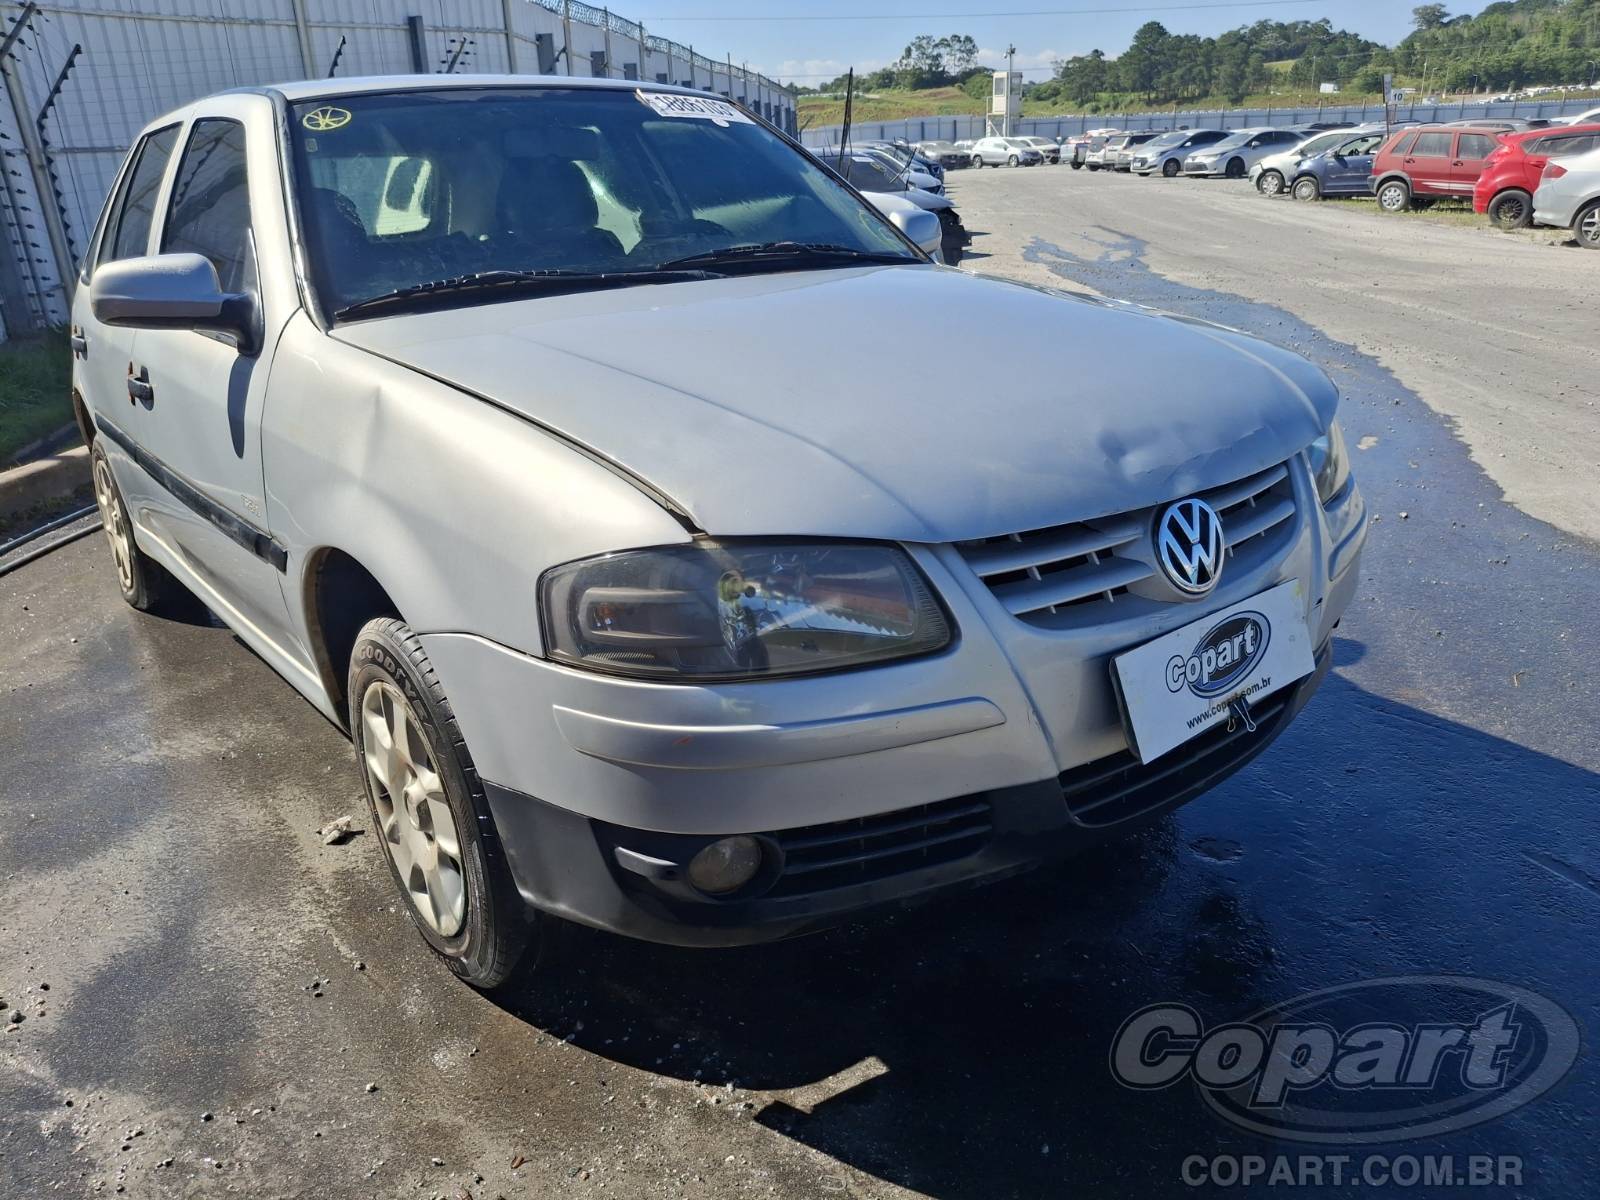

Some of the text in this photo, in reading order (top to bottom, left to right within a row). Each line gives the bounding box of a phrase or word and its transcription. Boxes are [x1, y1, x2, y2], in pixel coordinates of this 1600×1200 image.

[1393, 93, 1403, 101] 10
[1165, 618, 1258, 693] Copart
[1186, 676, 1271, 729] www.copcom.br
